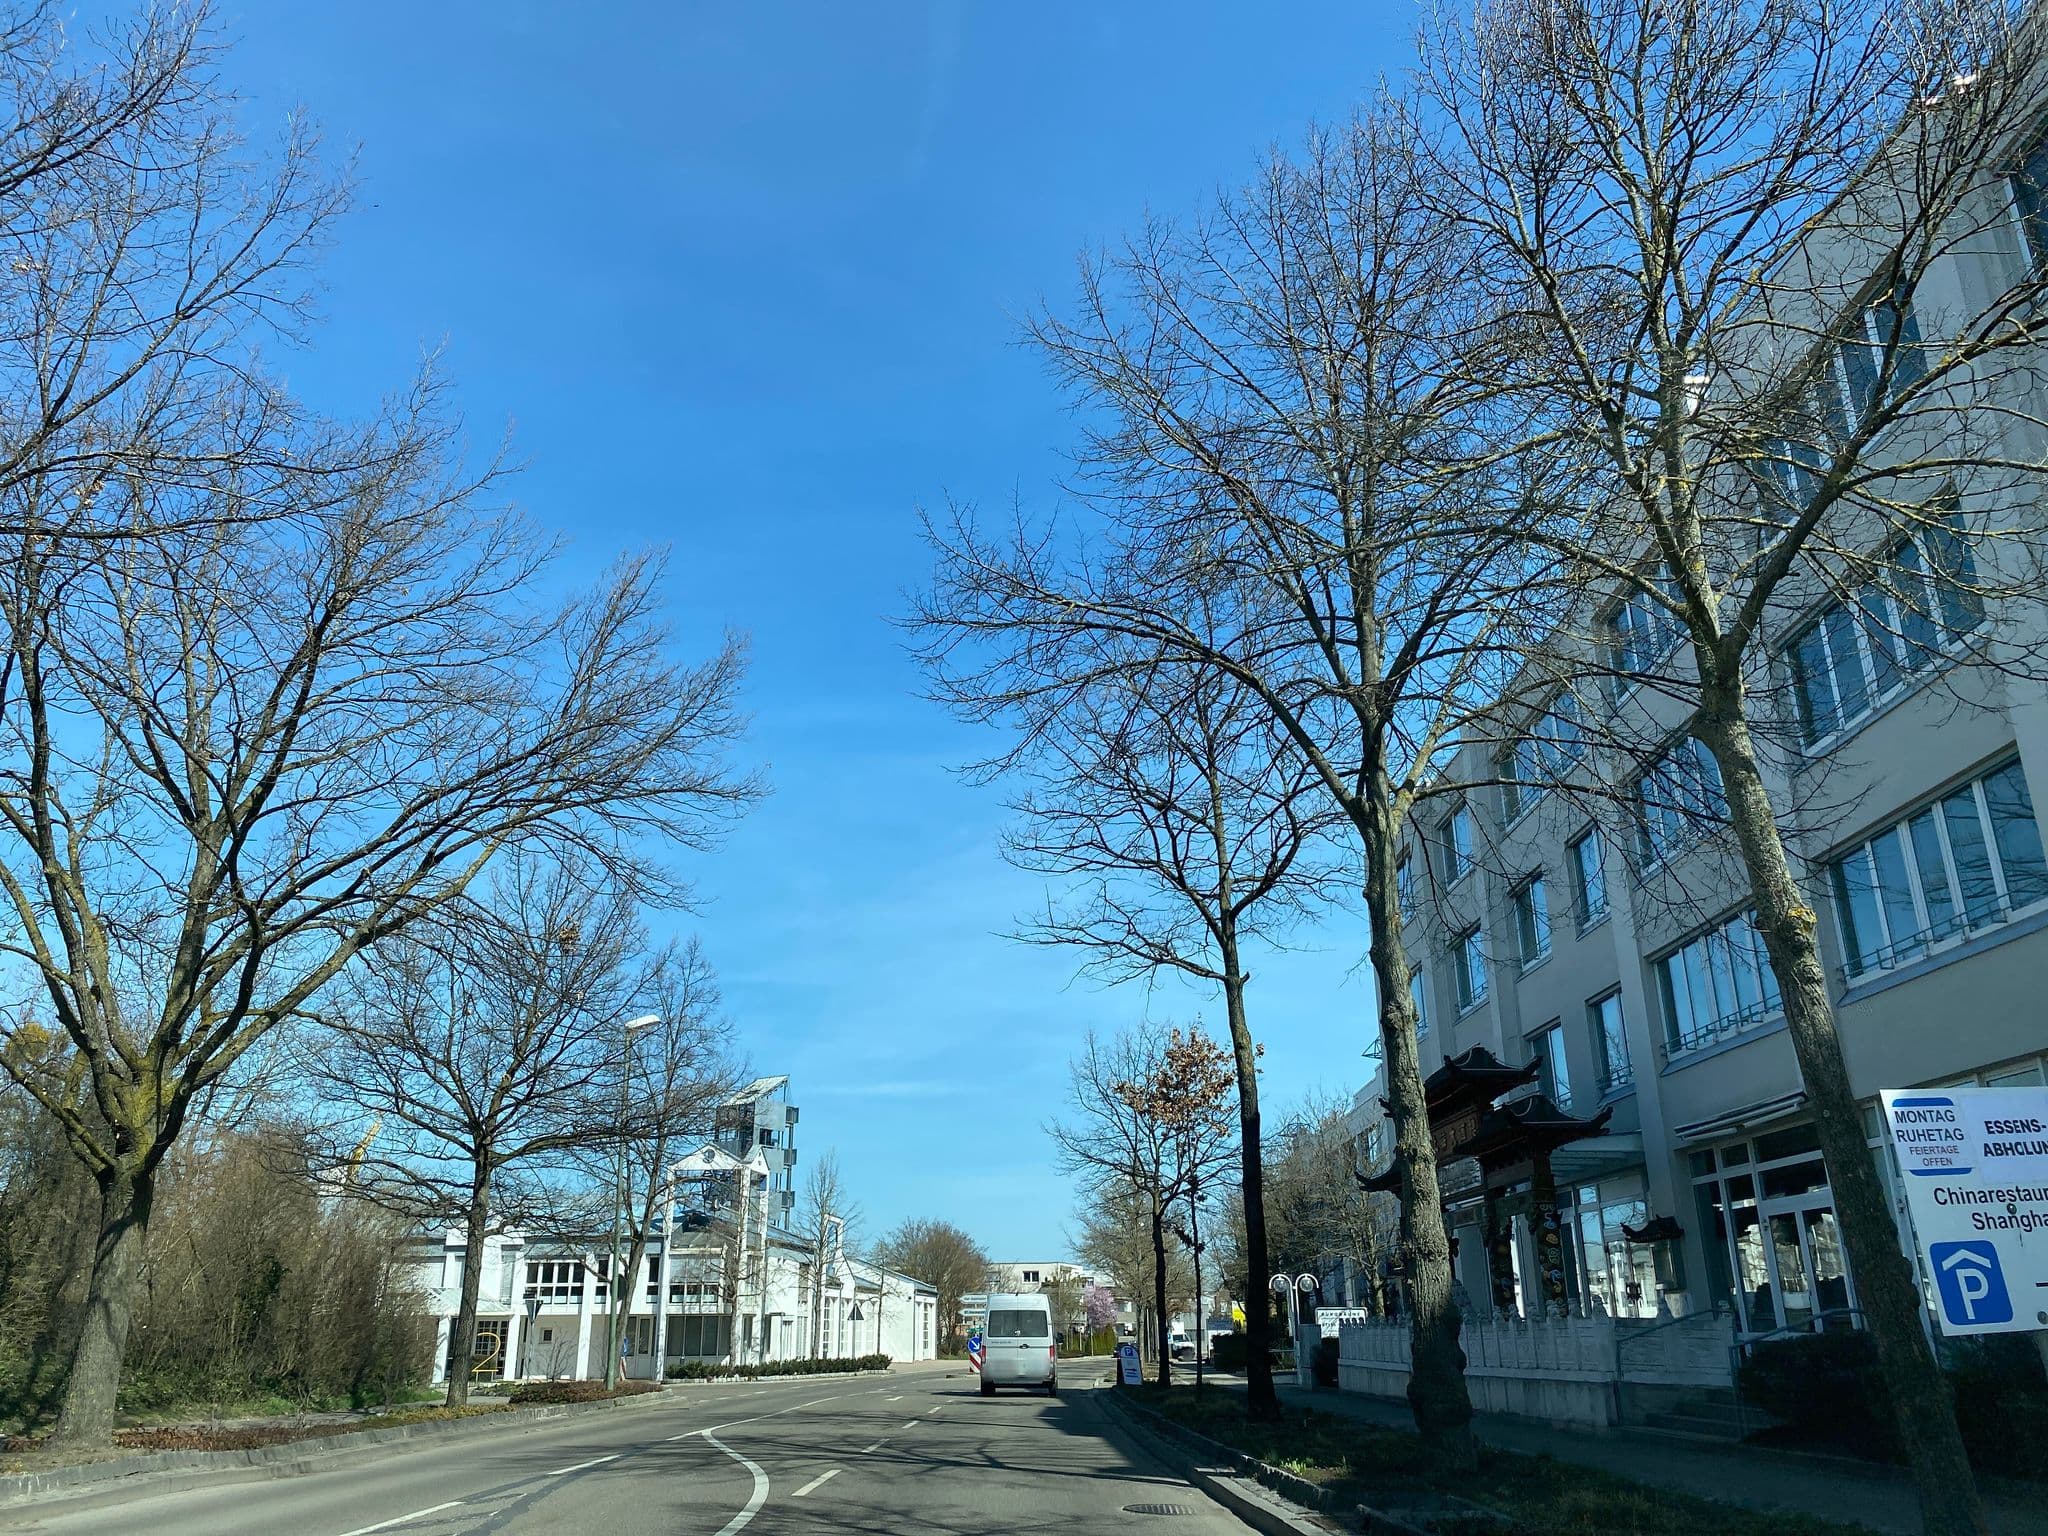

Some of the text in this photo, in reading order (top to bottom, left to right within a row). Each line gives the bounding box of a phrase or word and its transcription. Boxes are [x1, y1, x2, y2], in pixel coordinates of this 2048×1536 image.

[1894, 1109, 1955, 1124] MONTAG
[1984, 1118, 2047, 1135] ESSENS-
[1896, 1128, 1965, 1143] RUHETAG
[1909, 1145, 1960, 1155] FEIERTAGE
[1922, 1157, 1953, 1167] OFFEN
[1955, 1267, 1989, 1321] P
[471, 1331, 502, 1373] 2
